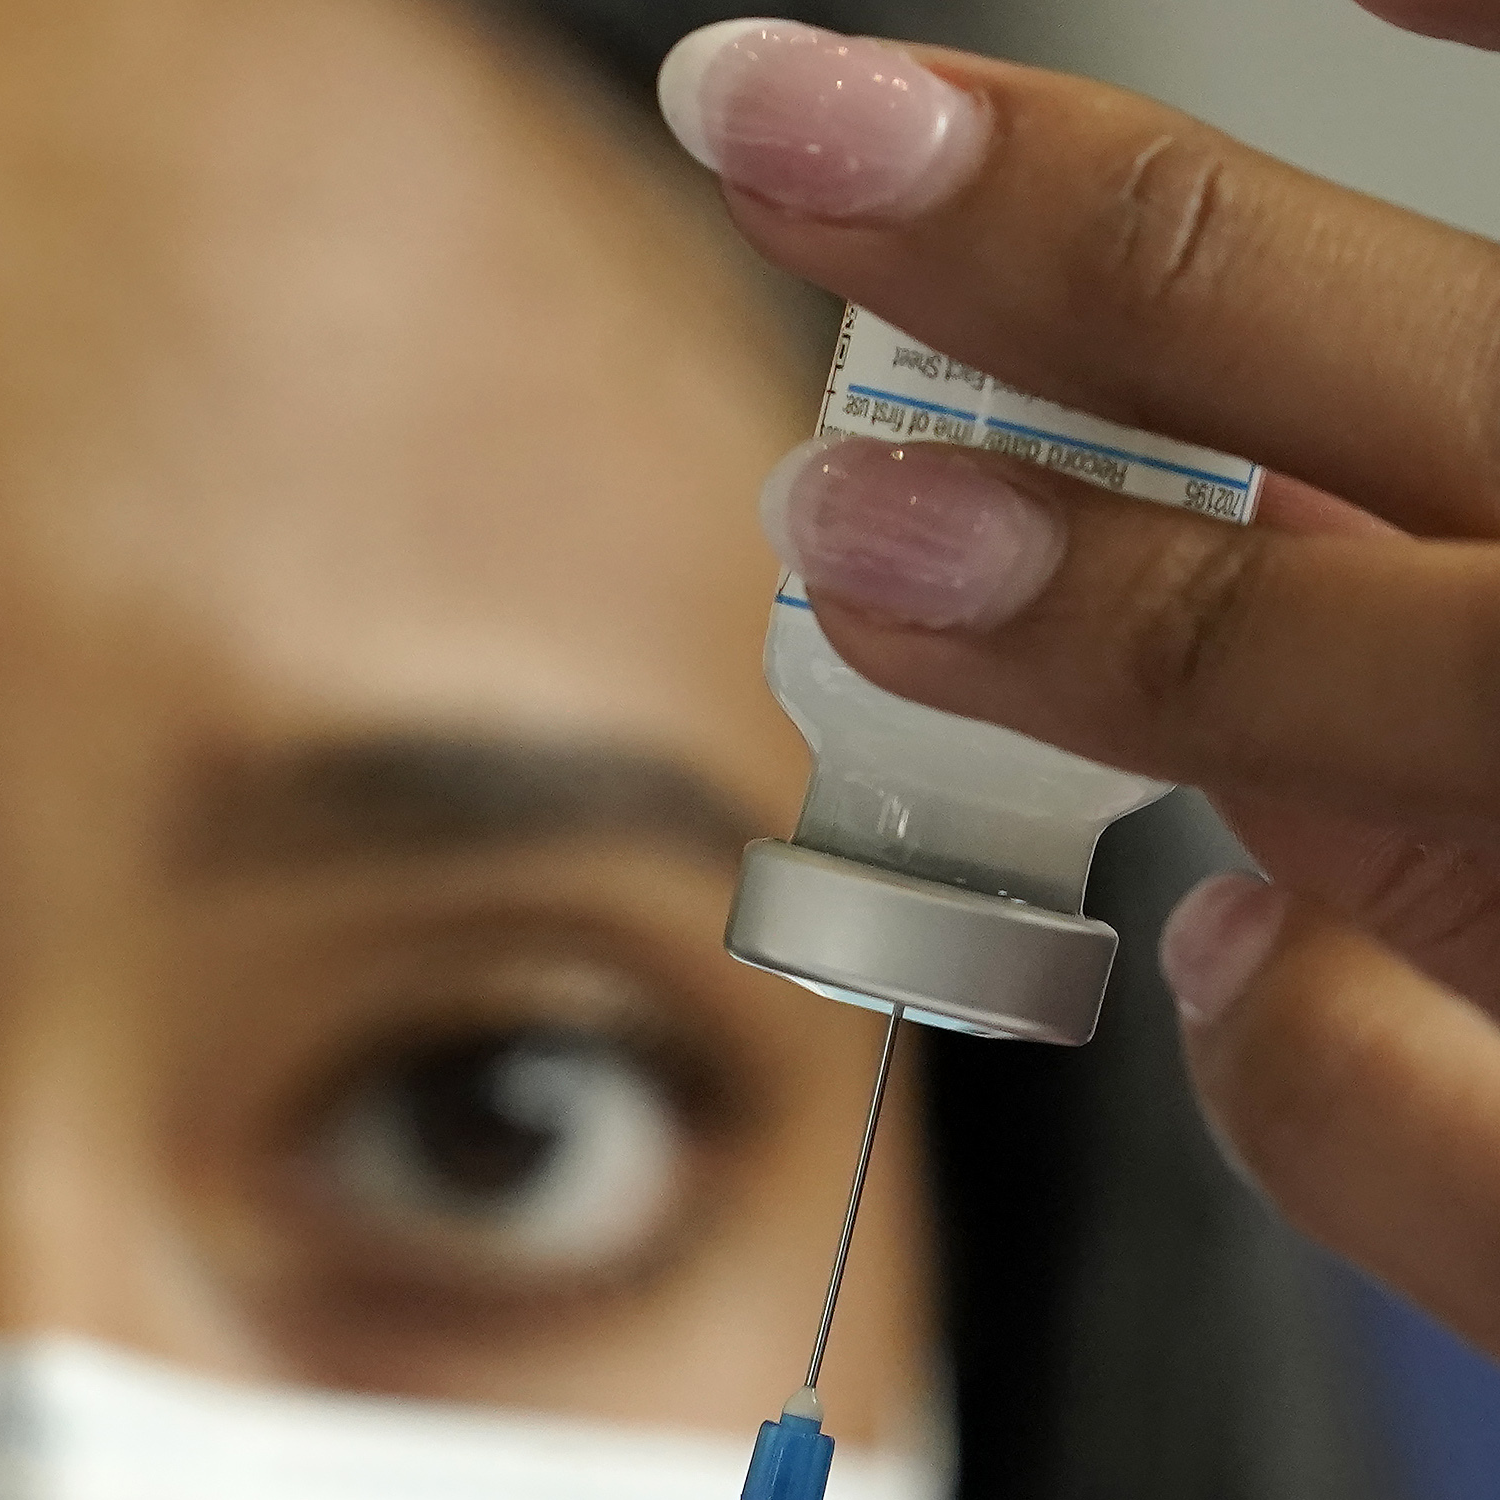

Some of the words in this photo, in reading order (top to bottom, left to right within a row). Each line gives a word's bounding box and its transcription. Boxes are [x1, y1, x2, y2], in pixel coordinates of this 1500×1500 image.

[893, 346, 941, 379] Sheet
[871, 401, 905, 432] first
[908, 410, 930, 437] of
[1047, 448, 1128, 487] Record
[1182, 480, 1240, 517] 702195
